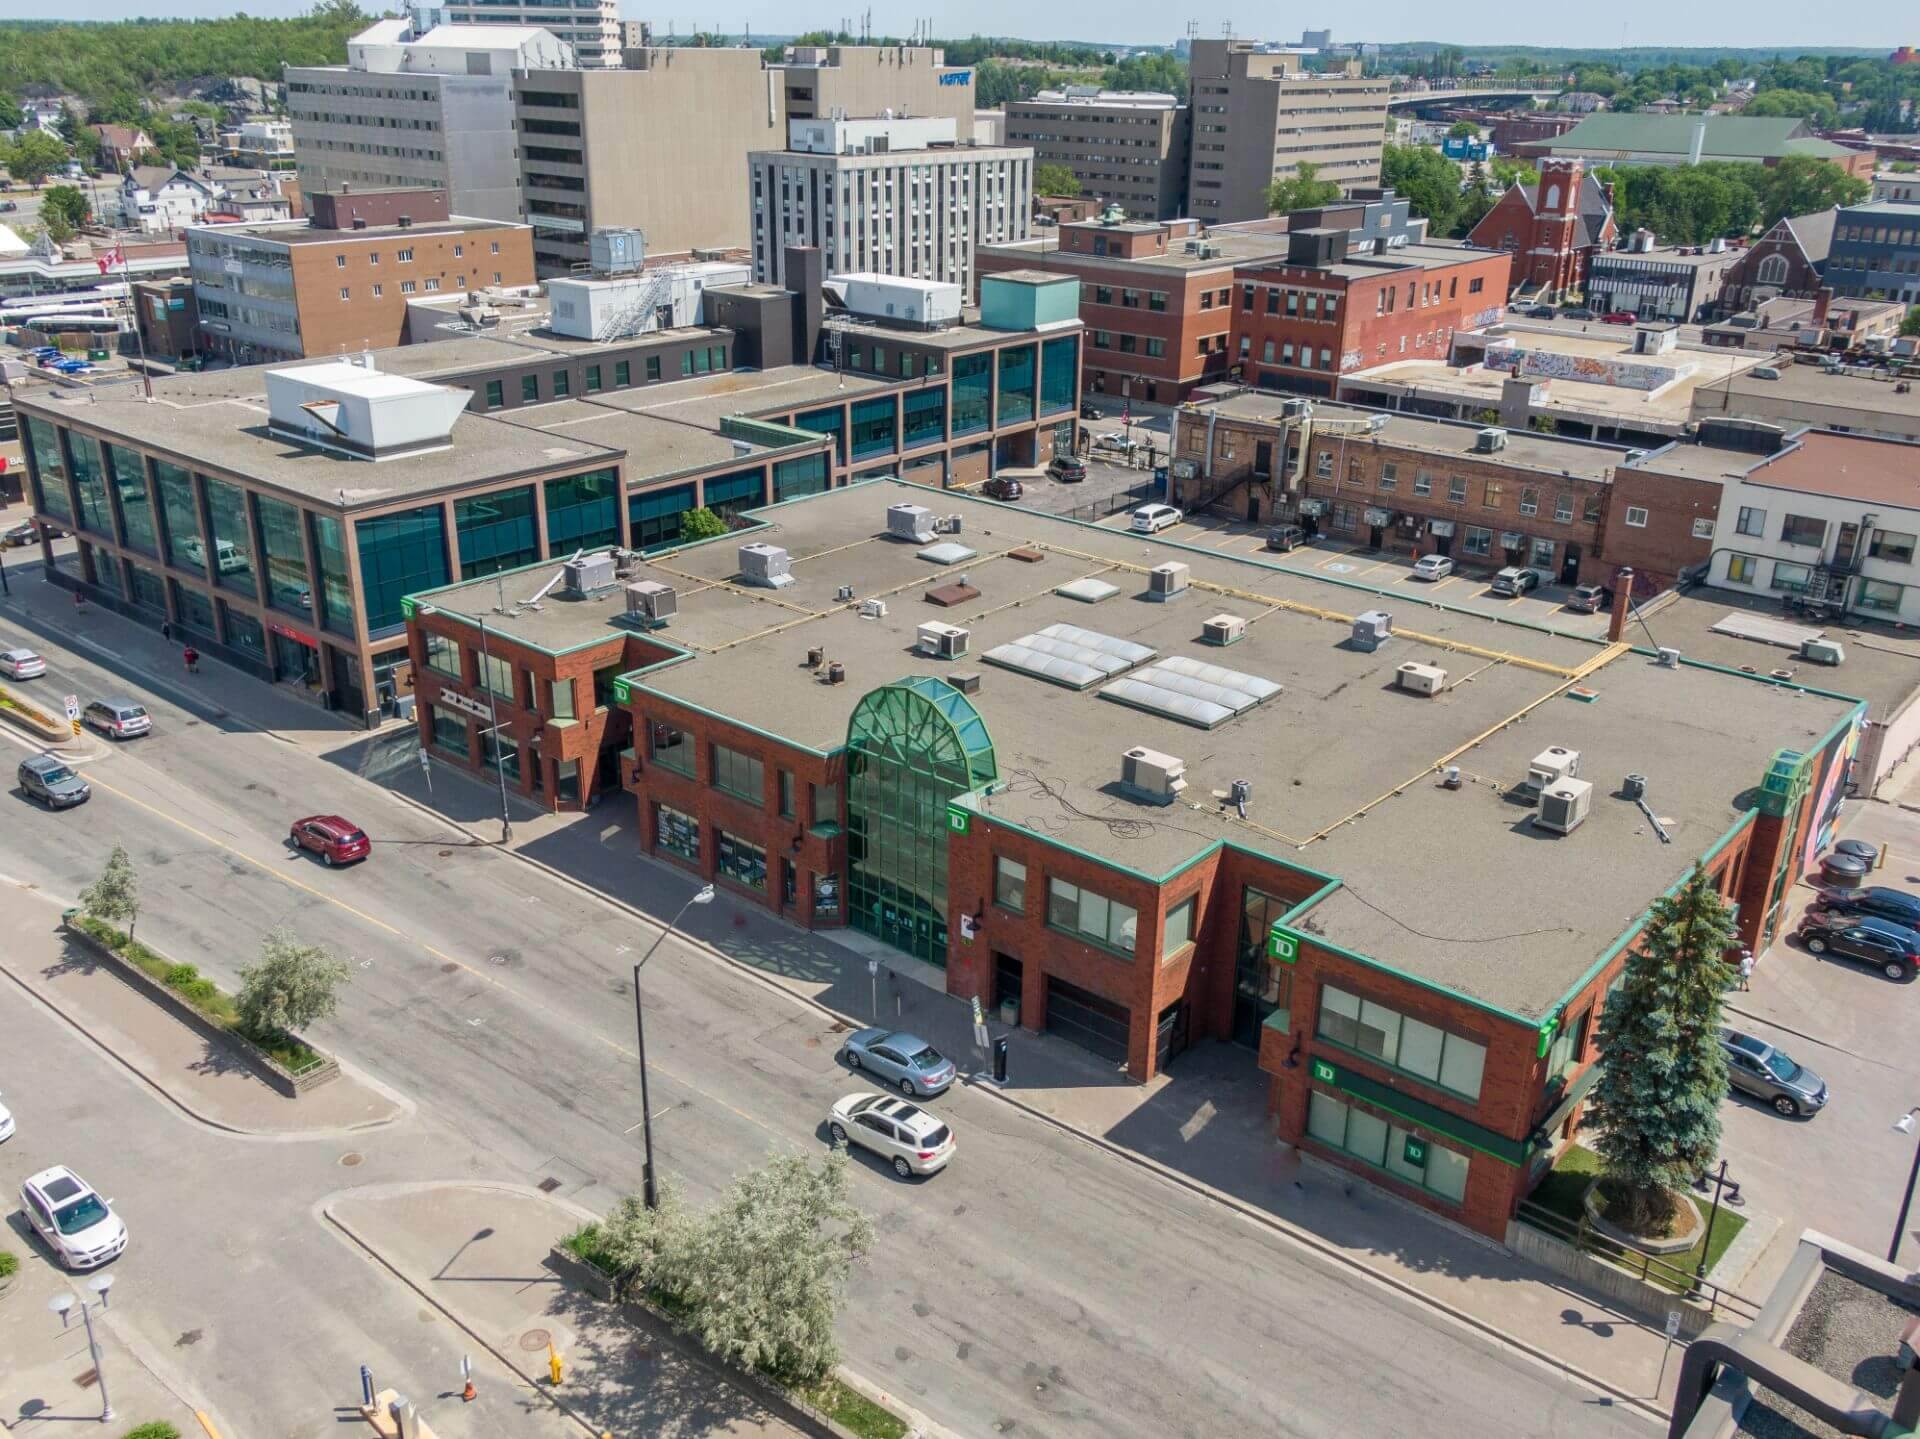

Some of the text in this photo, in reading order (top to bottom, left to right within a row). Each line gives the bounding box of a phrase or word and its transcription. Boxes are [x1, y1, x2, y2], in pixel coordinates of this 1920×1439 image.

[614, 687, 627, 700] TD
[948, 814, 965, 830] TD
[1272, 936, 1293, 957] TD
[1317, 1064, 1333, 1080] TD
[1409, 1145, 1422, 1158] TD
